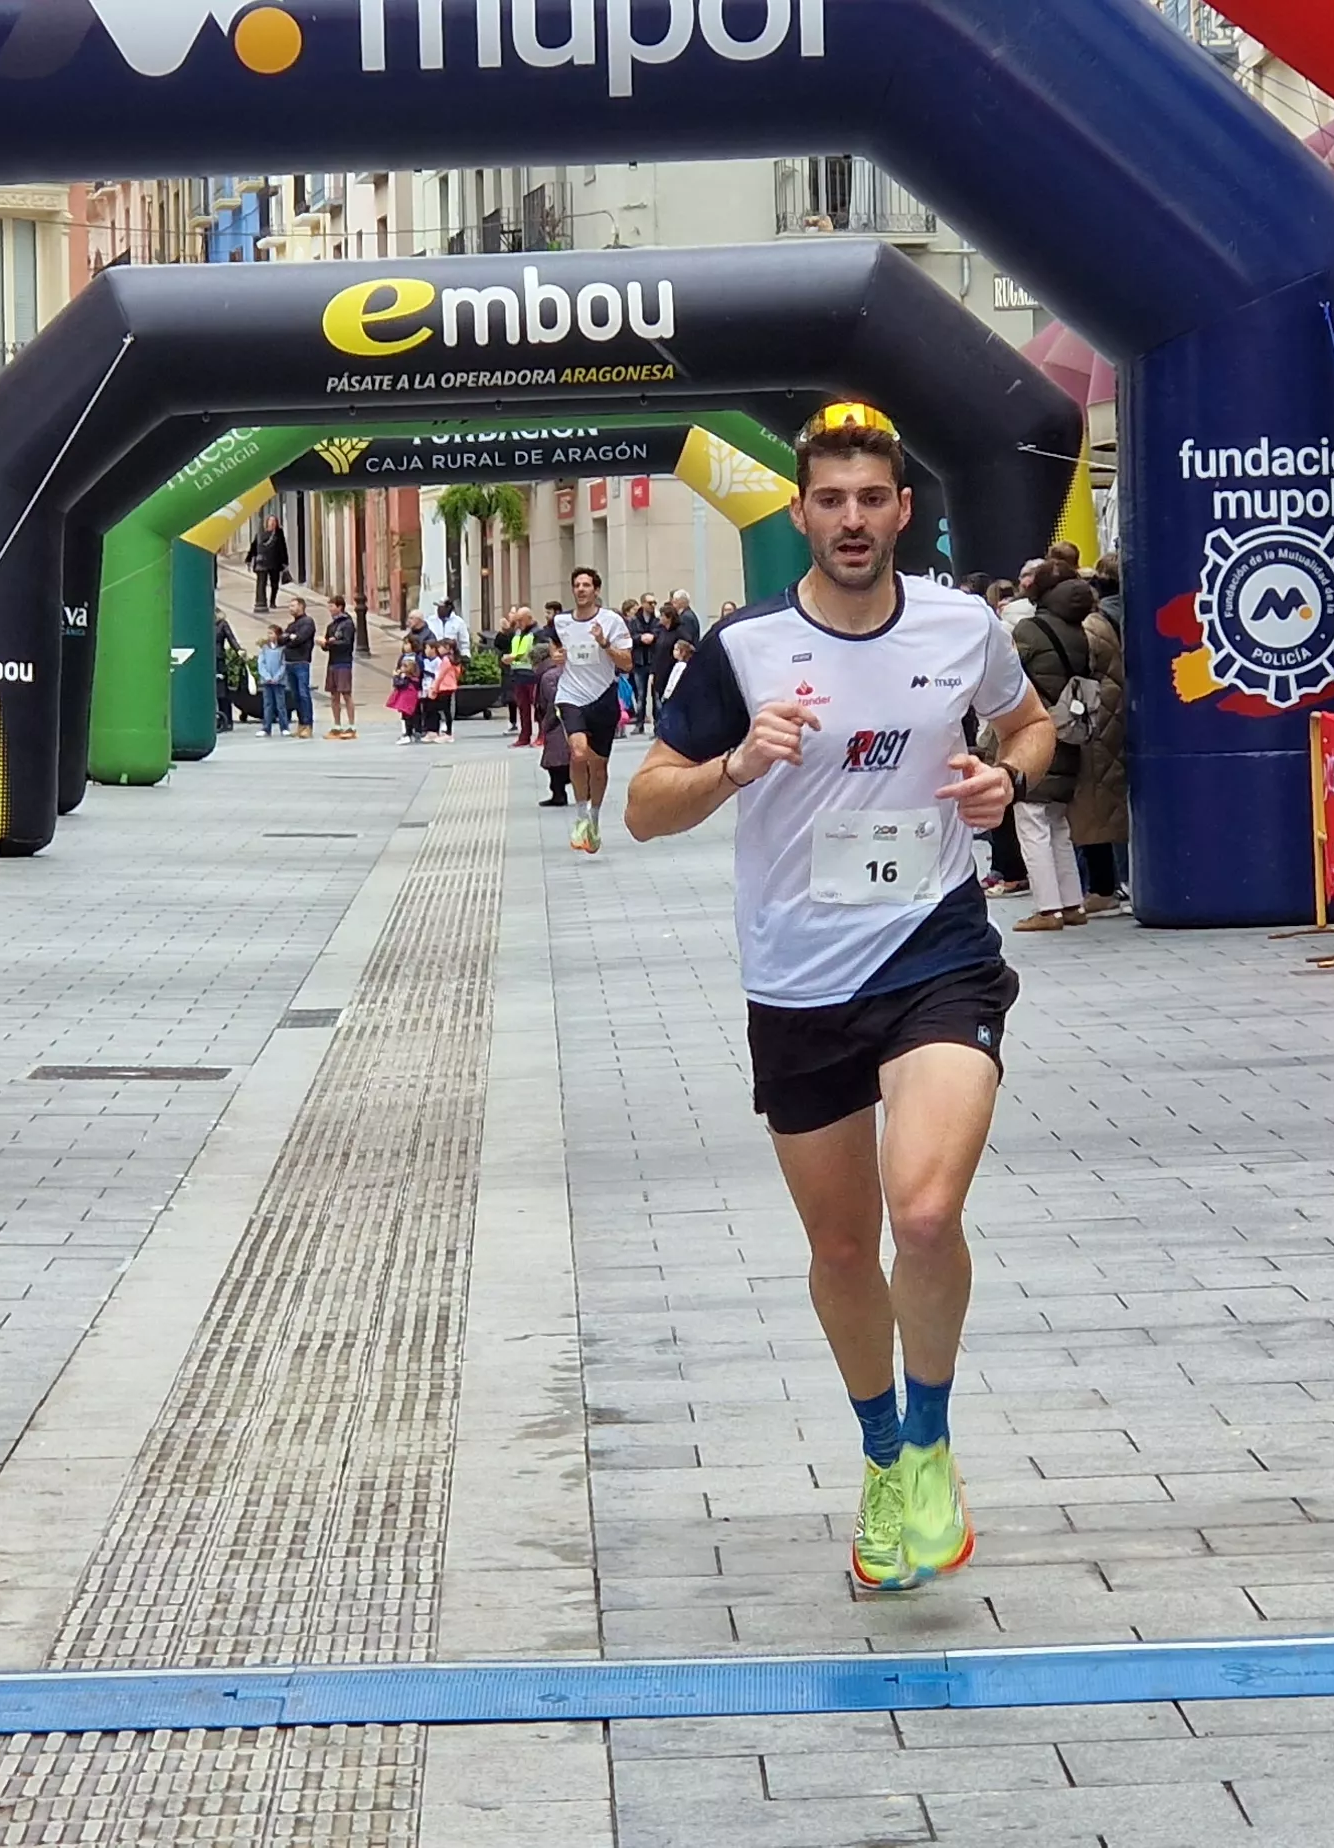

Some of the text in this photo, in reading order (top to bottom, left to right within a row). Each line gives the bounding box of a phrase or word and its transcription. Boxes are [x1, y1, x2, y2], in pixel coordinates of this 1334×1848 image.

[322, 265, 674, 357] embou
[326, 363, 675, 393] PÁSATE A LA OPERADORA ARAGONESA
[365, 440, 648, 474] CAJA RURAL DE ARAGÓN
[193, 472, 214, 491] La
[1224, 560, 1251, 619] Fundación
[1249, 552, 1263, 566] de
[1265, 550, 1276, 561] la
[1277, 548, 1332, 587] Mutualidad
[1251, 645, 1313, 667] POLICÍA
[866, 860, 898, 883] 16
